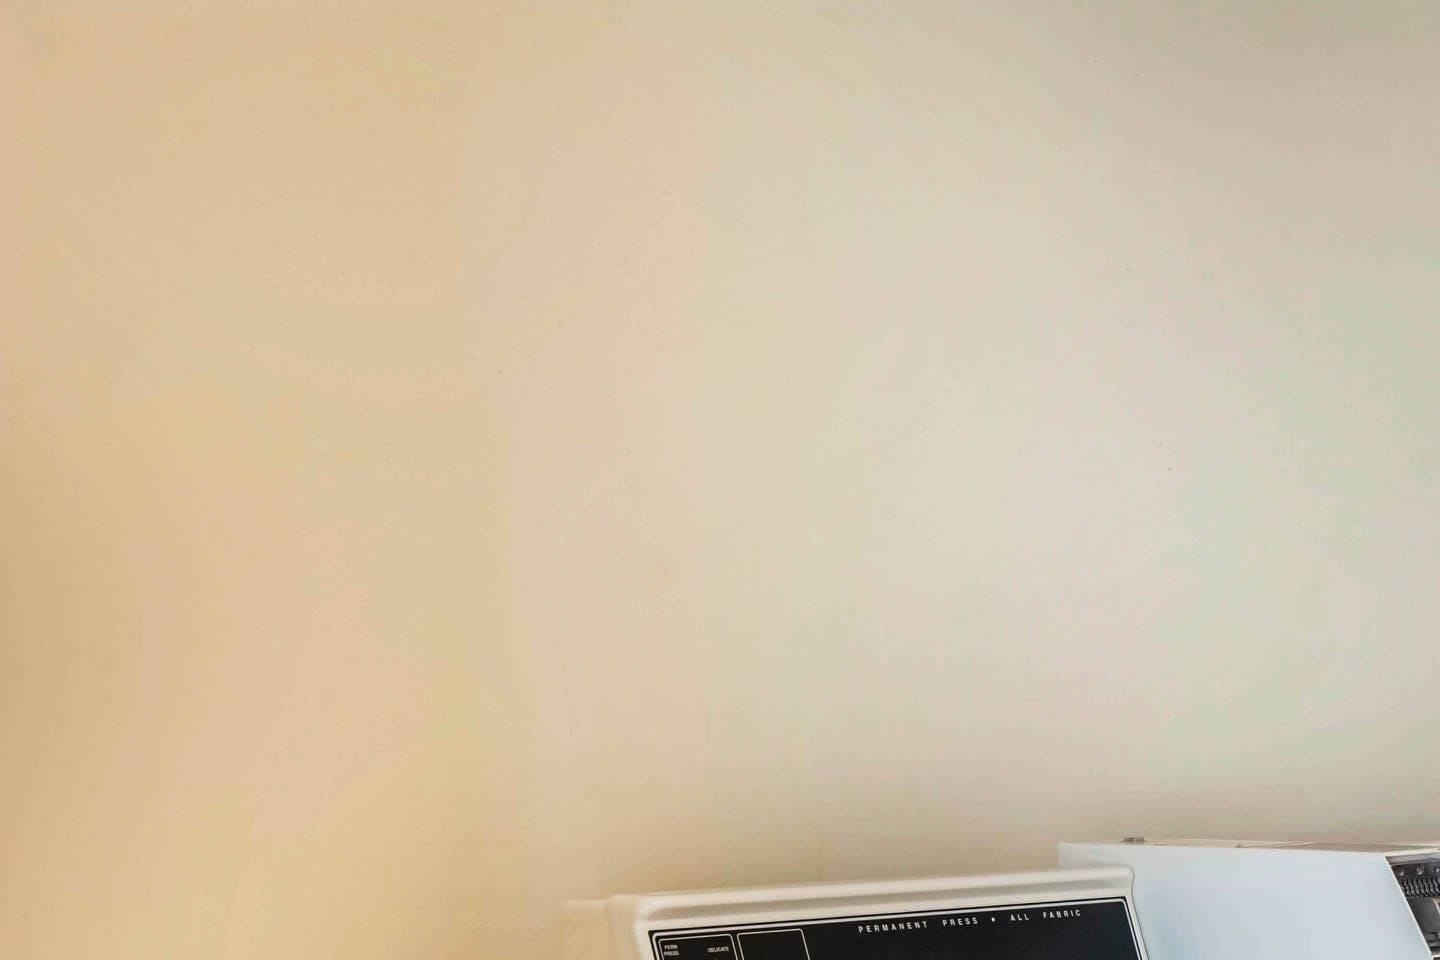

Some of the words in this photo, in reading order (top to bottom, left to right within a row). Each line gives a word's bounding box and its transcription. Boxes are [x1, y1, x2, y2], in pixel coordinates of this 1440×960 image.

[858, 920, 928, 934] PERMANENT
[942, 916, 979, 927] PRESS
[1009, 913, 1030, 922] ALL
[1042, 909, 1082, 919] FABRIC
